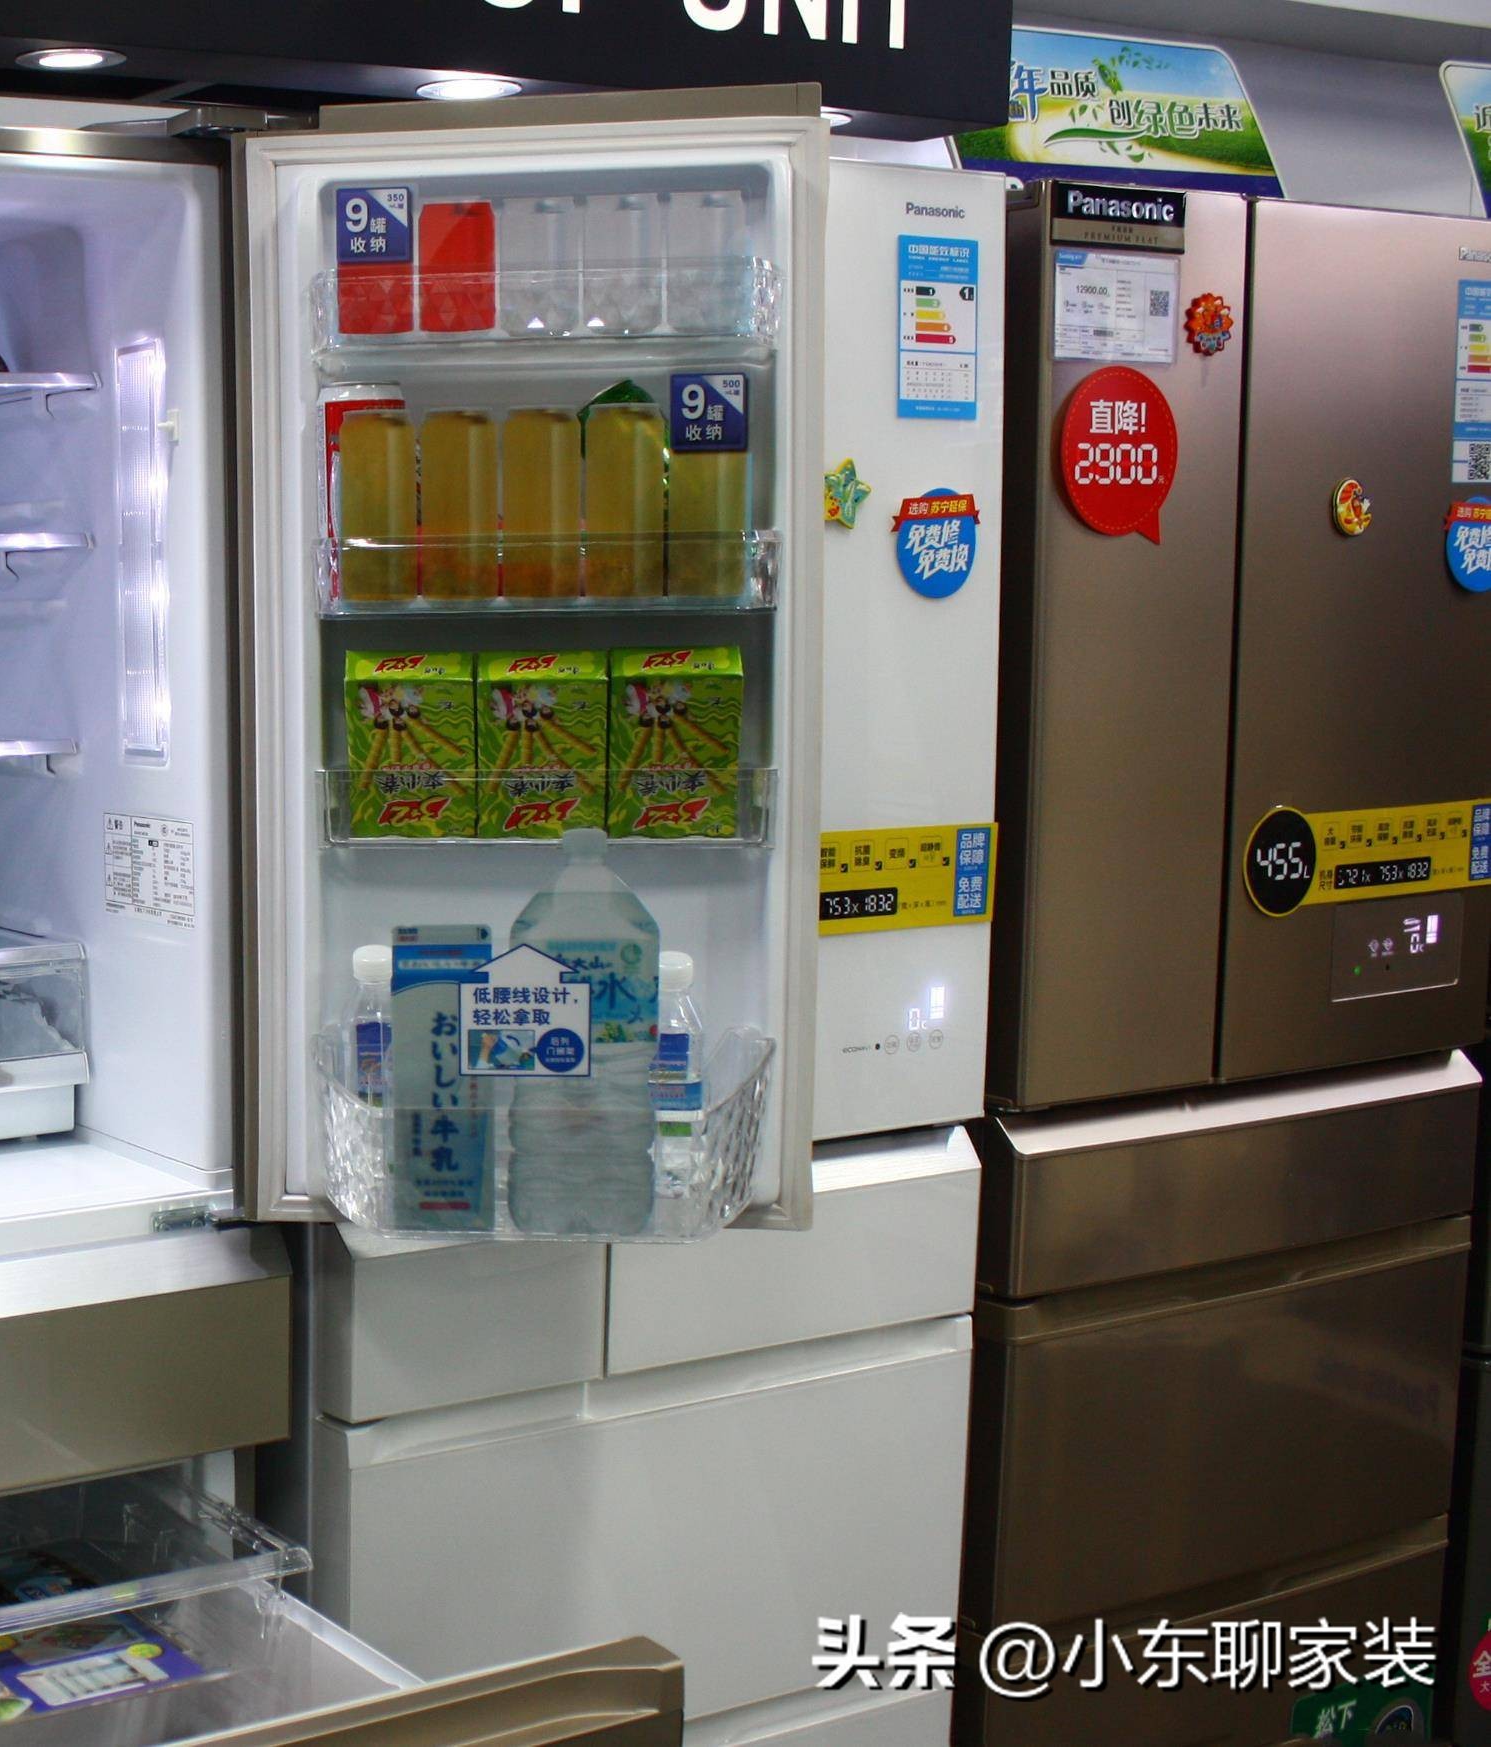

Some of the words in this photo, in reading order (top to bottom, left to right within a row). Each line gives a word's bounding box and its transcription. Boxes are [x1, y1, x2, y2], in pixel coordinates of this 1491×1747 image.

[1109, 99, 1244, 138] 创绿色未来
[387, 194, 404, 202] 350
[905, 202, 965, 219] Panasonic
[1067, 190, 1174, 221] Panasonic
[350, 237, 386, 253] 收纳
[723, 380, 740, 388] 500
[1089, 400, 1146, 435] 直降!
[685, 424, 723, 441] 收纳
[1075, 443, 1158, 485] 2900
[905, 519, 961, 556] 免费修
[915, 543, 969, 580] 免费换
[1461, 548, 1491, 575] 免费
[473, 1008, 550, 1025] 轻松拿取
[430, 1011, 459, 1172] おいしい牛乳
